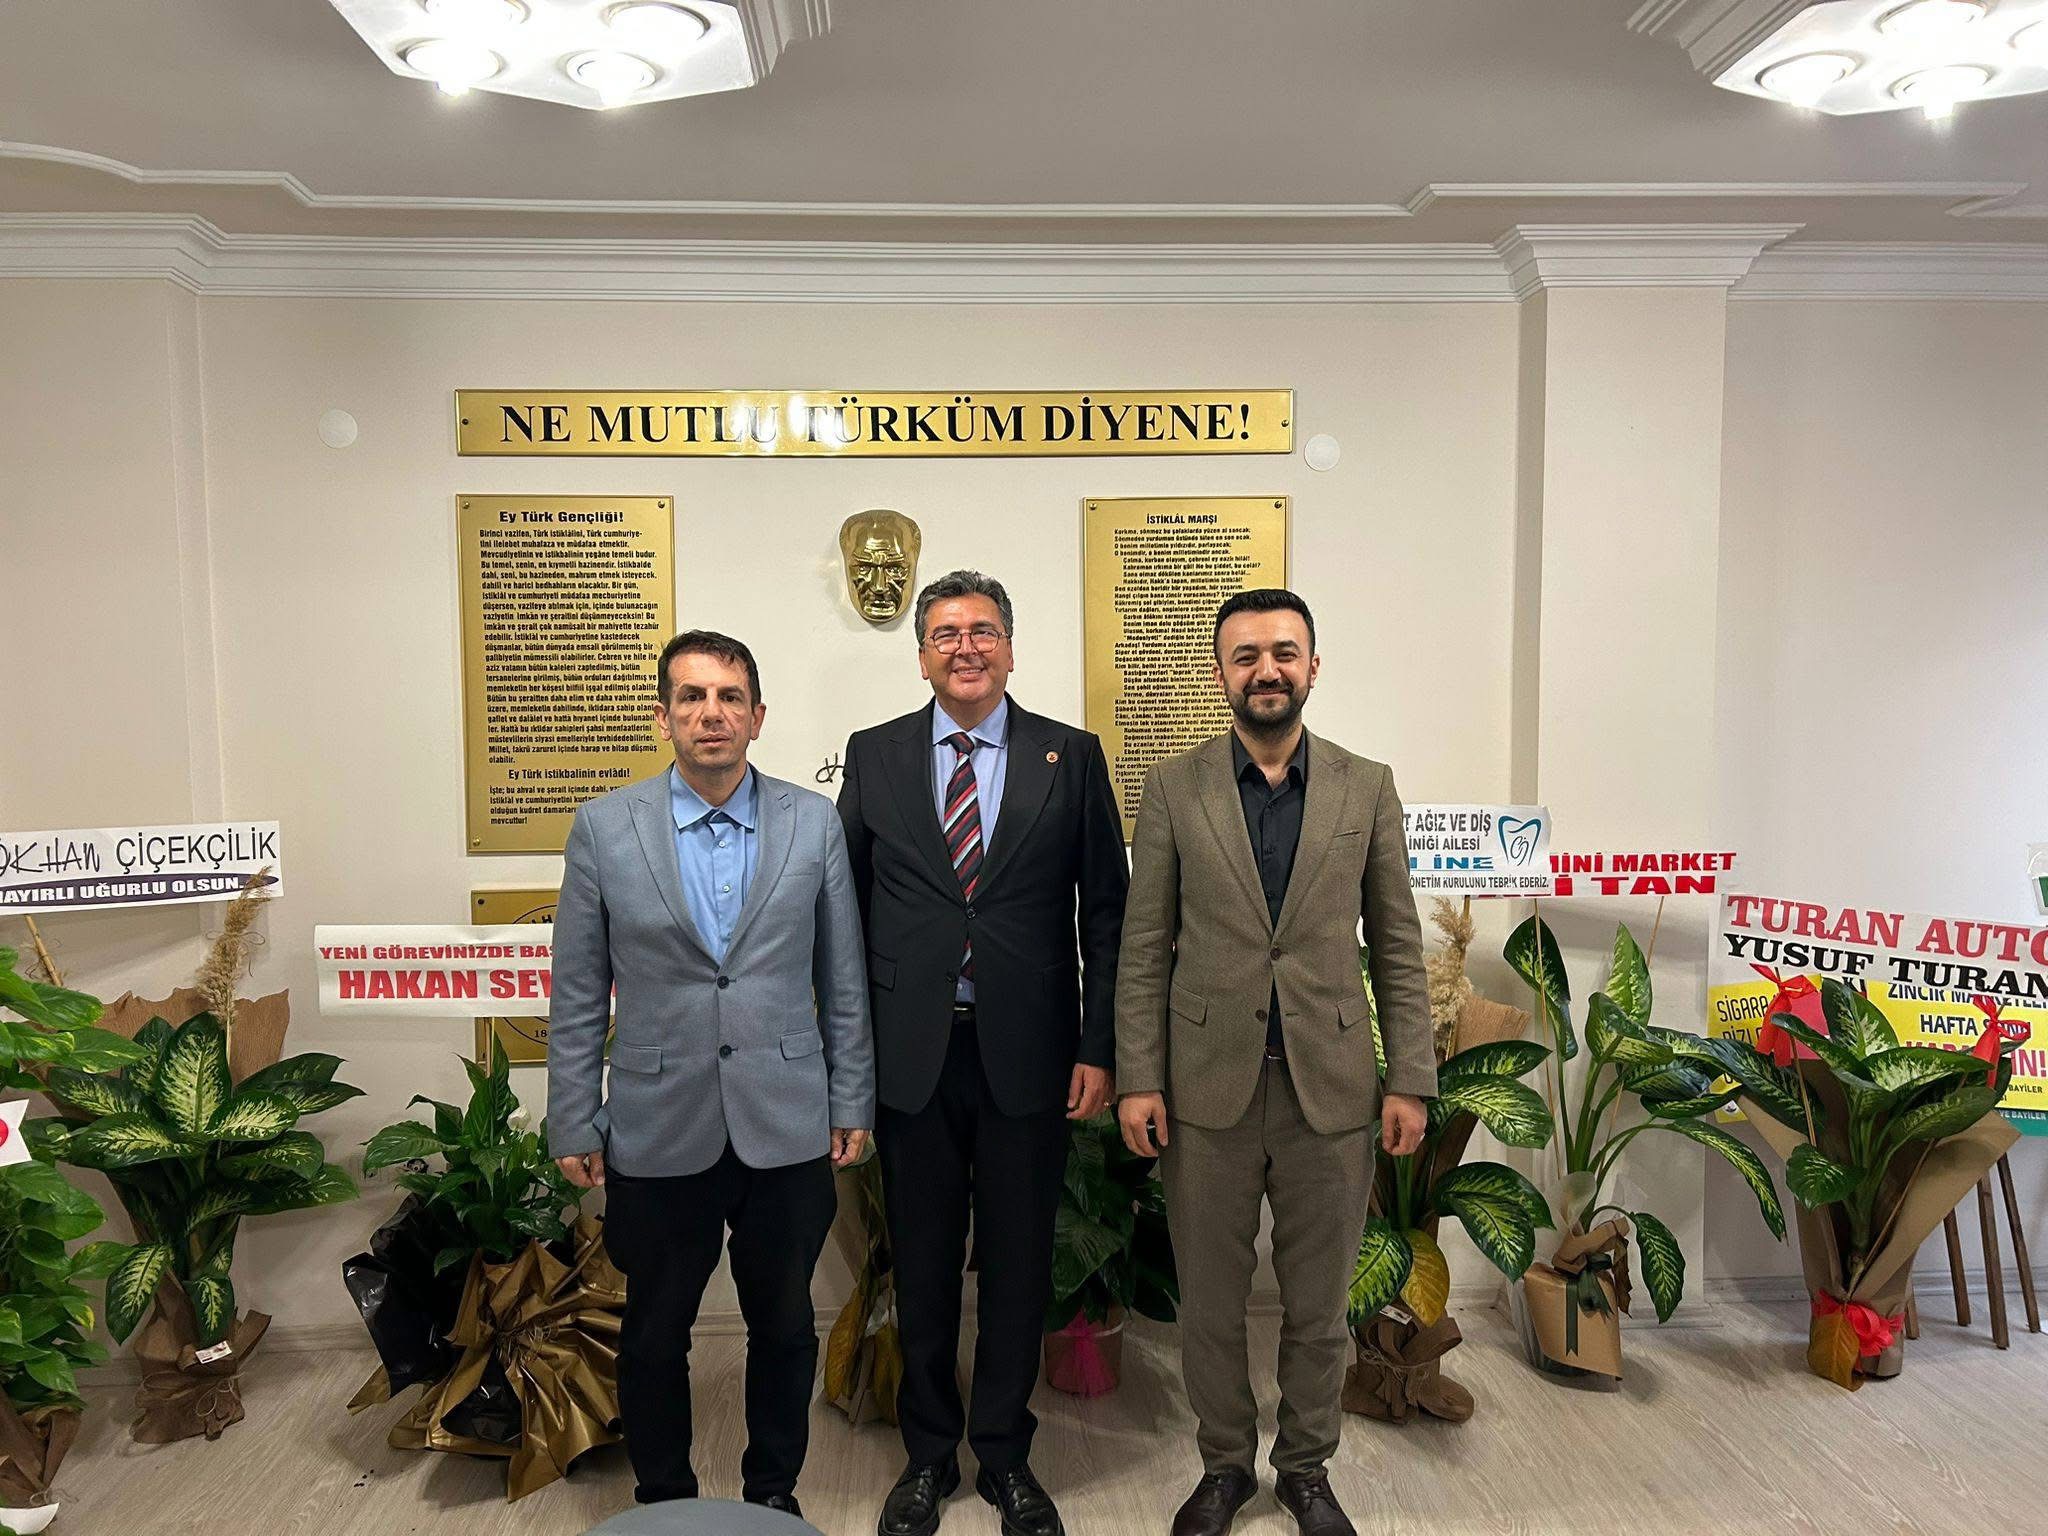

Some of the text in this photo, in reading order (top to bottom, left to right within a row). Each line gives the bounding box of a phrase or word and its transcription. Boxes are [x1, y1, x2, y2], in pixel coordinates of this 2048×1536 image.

[500, 395, 1251, 444] NE MUTLU TÜRKÜM DİYENE!
[500, 511, 623, 524] Ey Türk Gençliği!
[1147, 513, 1217, 525] İSTİKLÂL MARŞI
[504, 530, 532, 538] vazifen,
[533, 529, 548, 537] Türk
[604, 530, 642, 538] cumhuriye-
[522, 540, 555, 548] muhafaza
[567, 540, 596, 548] müdafaa
[599, 540, 629, 548] etmektir.
[481, 550, 533, 559] Mevcudiyetinin
[636, 550, 656, 558] budur.
[492, 559, 514, 569] temel,
[516, 561, 536, 569] senin,
[549, 561, 576, 569] kıymetli
[482, 571, 498, 579] dahi,
[501, 569, 517, 579] seni,
[530, 571, 567, 579] hazineden,
[485, 643, 523, 652] düşmanlar,
[546, 643, 574, 651] dünyada
[576, 641, 599, 650] emsali
[601, 643, 642, 651] görülmemiş
[634, 651, 646, 660] hile
[489, 746, 510, 754] Millet,
[558, 745, 579, 753] içinde
[581, 745, 600, 753] harap
[612, 744, 629, 752] bitap
[631, 744, 657, 753] düşmüş
[509, 769, 519, 780] Ey
[522, 769, 542, 779] Türk
[599, 768, 629, 778] evlâdı!
[547, 786, 566, 795] şerait
[568, 786, 589, 794] içinde
[1415, 809, 1446, 831] AĞIZ
[1450, 814, 1466, 831] VE
[1470, 809, 1491, 836] DİŞ
[1443, 835, 1480, 850] AİLESİ
[116, 827, 277, 874] ÇİÇEKÇİLİK
[1612, 852, 1737, 872] MARKET
[1443, 876, 1486, 888] KURULUNU
[1488, 874, 1517, 888] TEBRİK
[1520, 874, 1549, 888] EDERİZ.
[1591, 876, 1715, 895] TAN
[0, 887, 74, 903] AYIRLI
[80, 880, 167, 899] UĞURLU
[1727, 895, 1904, 948] TURAN
[319, 944, 367, 960] YENİ
[373, 944, 514, 959] GÖREVİNİZDE
[1723, 933, 1873, 977] YUSUF
[338, 969, 478, 999] HAKAN
[1920, 1014, 1978, 1036] HAFTA
